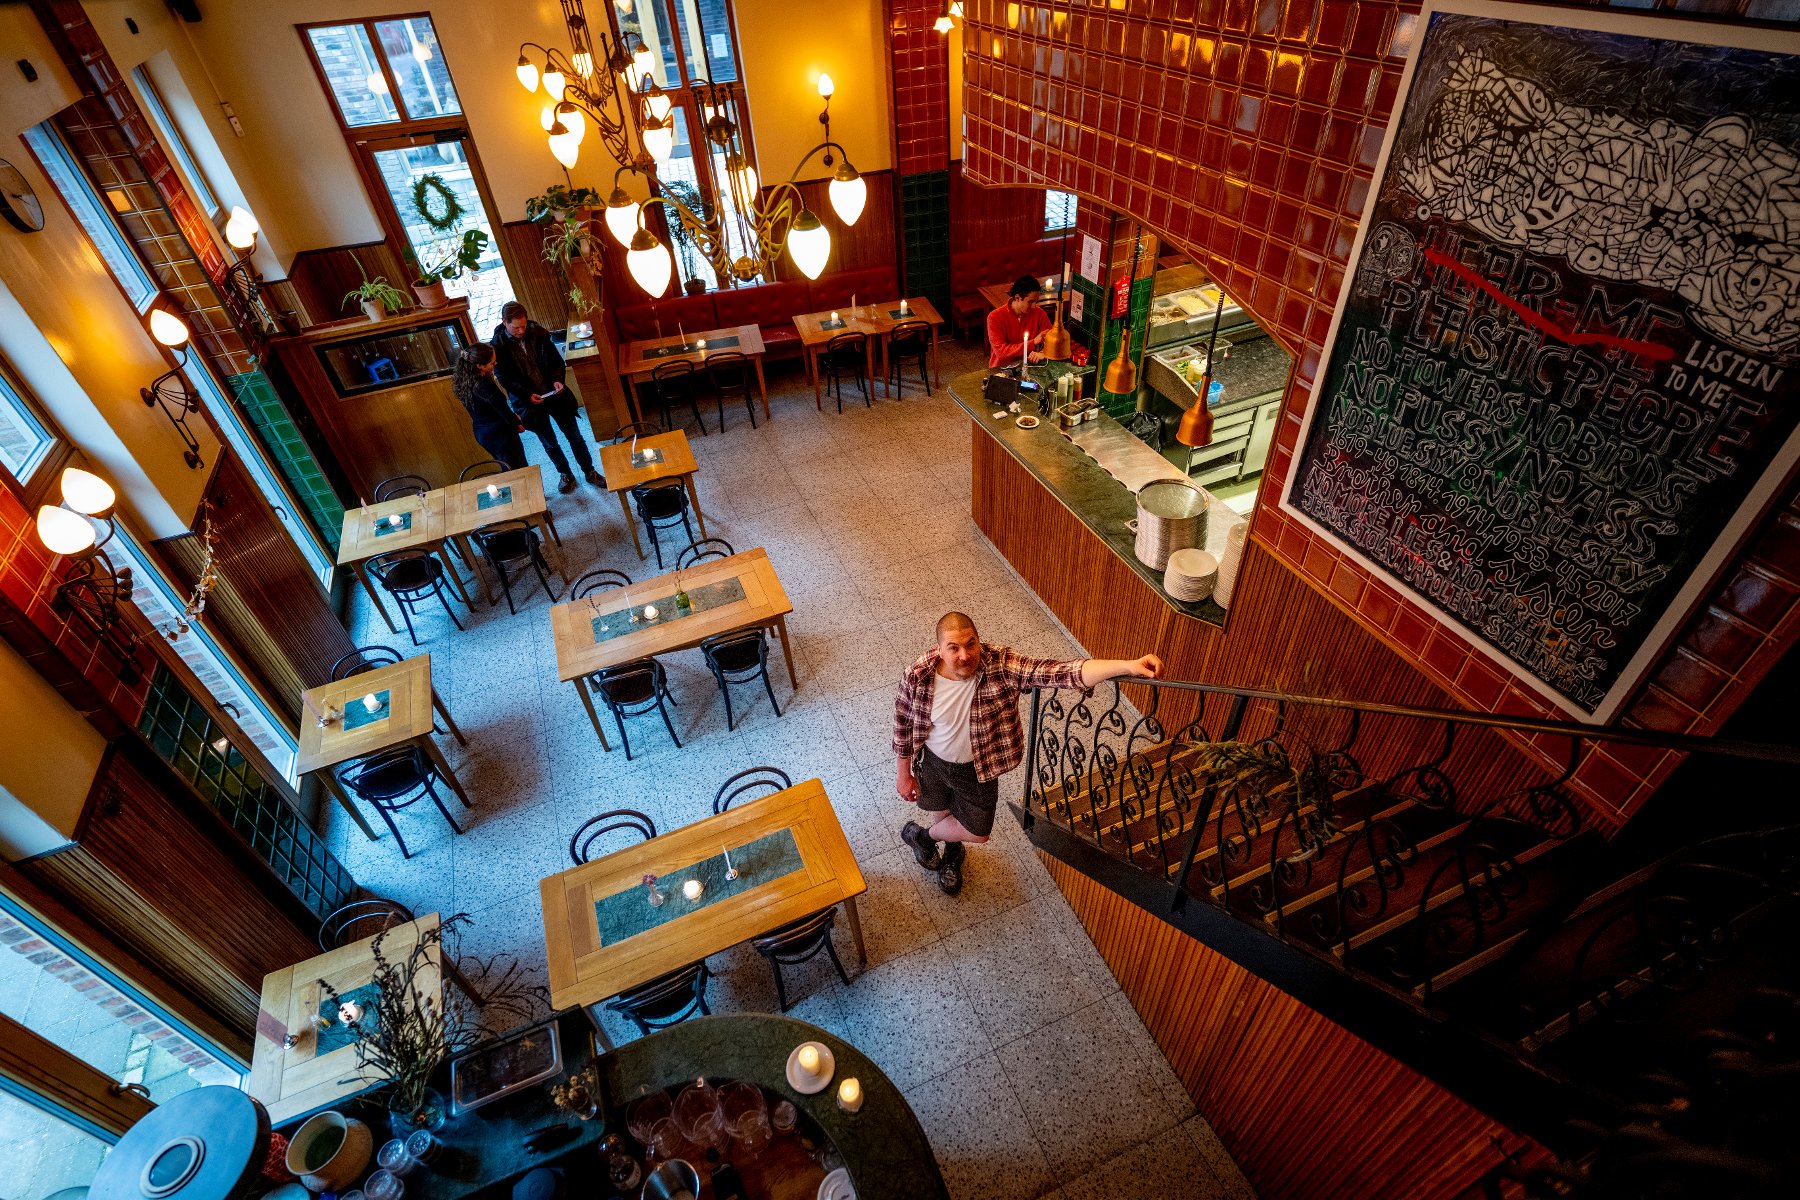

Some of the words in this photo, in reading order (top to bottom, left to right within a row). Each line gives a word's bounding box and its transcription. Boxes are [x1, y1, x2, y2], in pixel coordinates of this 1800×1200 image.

[1350, 327, 1393, 371] NO
[1519, 398, 1575, 454] NO
[1561, 349, 1768, 485] PEOPLE
[1663, 363, 1687, 392] TO
[1687, 376, 1733, 410] ME
[1312, 444, 1421, 519] Brother
[1419, 513, 1497, 567] and
[1328, 393, 1362, 429] NO
[1358, 407, 1415, 459] BLUE
[1472, 468, 1521, 520] NO
[1509, 491, 1590, 557] BLUE
[1574, 540, 1669, 593] SKY
[1340, 362, 1398, 410] NO
[1393, 383, 1524, 468] PUSSY
[1510, 446, 1576, 501] NO
[1562, 472, 1681, 560] ASS
[1303, 467, 1335, 500] NO
[1333, 483, 1391, 538] MORE
[1390, 515, 1441, 565] LIES
[1437, 551, 1454, 571] &
[1448, 556, 1484, 594] NO
[1479, 578, 1541, 639] MORE
[1581, 580, 1642, 627] 2017
